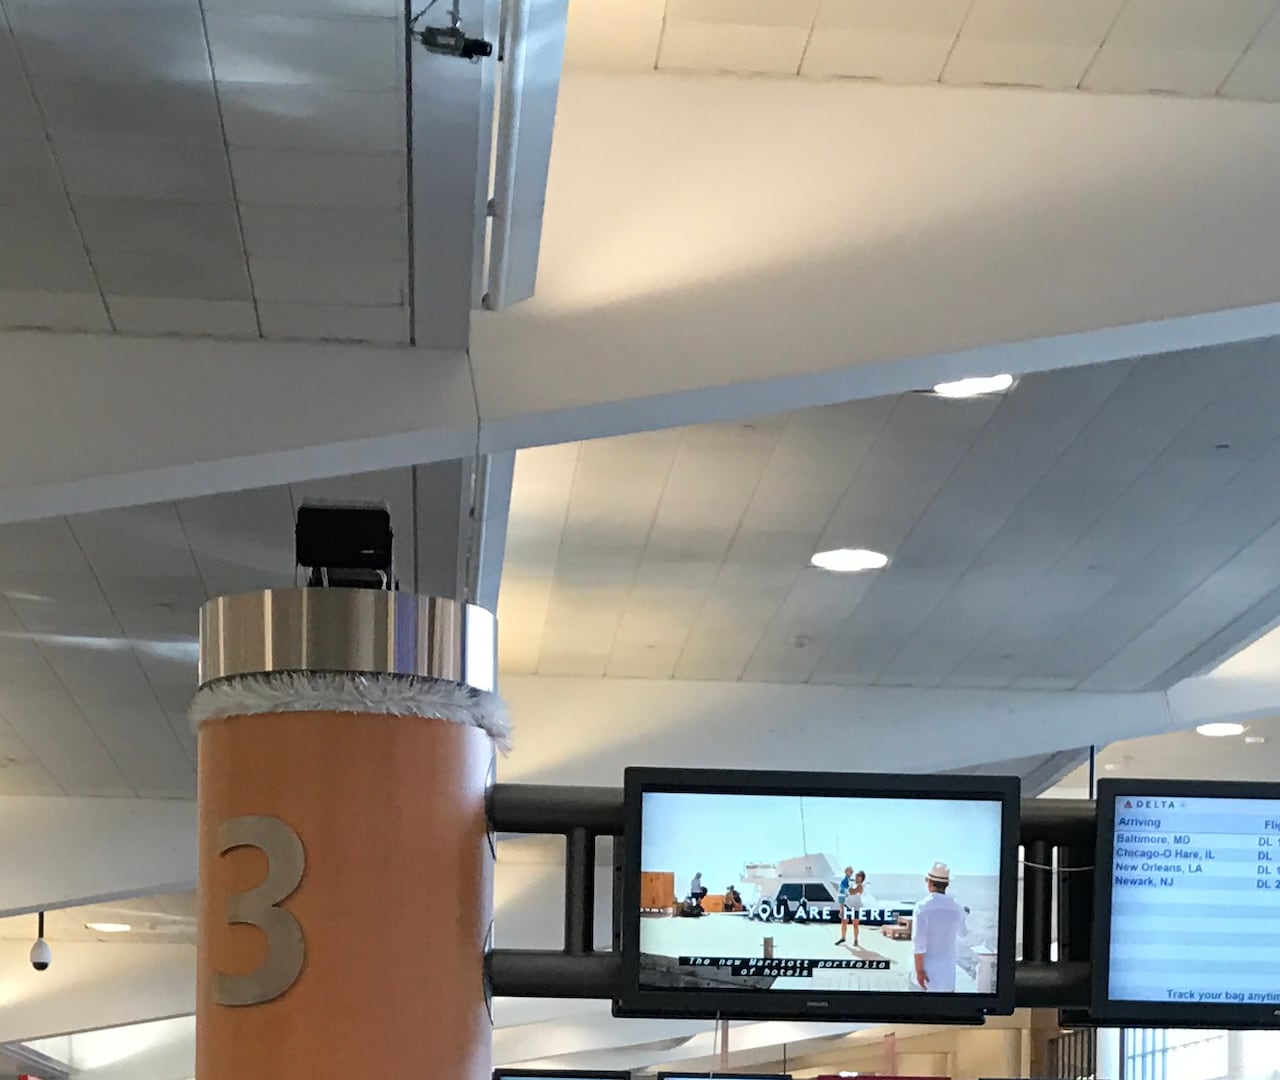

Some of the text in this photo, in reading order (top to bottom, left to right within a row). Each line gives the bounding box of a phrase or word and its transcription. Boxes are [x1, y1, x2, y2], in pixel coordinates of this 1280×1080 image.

[1136, 801, 1175, 809] DELTA
[1119, 817, 1161, 829] Arriving
[1117, 834, 1170, 845] Baltimore,
[1173, 835, 1190, 844] MD
[1258, 838, 1272, 847] DL
[1205, 851, 1215, 859] IL
[1258, 851, 1272, 860] DL
[1116, 863, 1138, 872] New
[1141, 863, 1185, 874] Orleans,
[1188, 864, 1203, 873] LA
[1257, 866, 1271, 875] DL
[1115, 877, 1157, 887] Newark,
[1160, 878, 1174, 886] NJ
[1257, 880, 1271, 888] DL
[215, 815, 305, 1007] 3
[748, 904, 893, 921] YOU ARE HERE
[689, 957, 710, 966] The
[749, 958, 809, 967] Marriott
[817, 959, 886, 969] portfolio
[741, 967, 809, 976] of hotels
[1166, 989, 1195, 999] Track
[1198, 992, 1222, 1001] your
[1225, 991, 1244, 1001] bag
